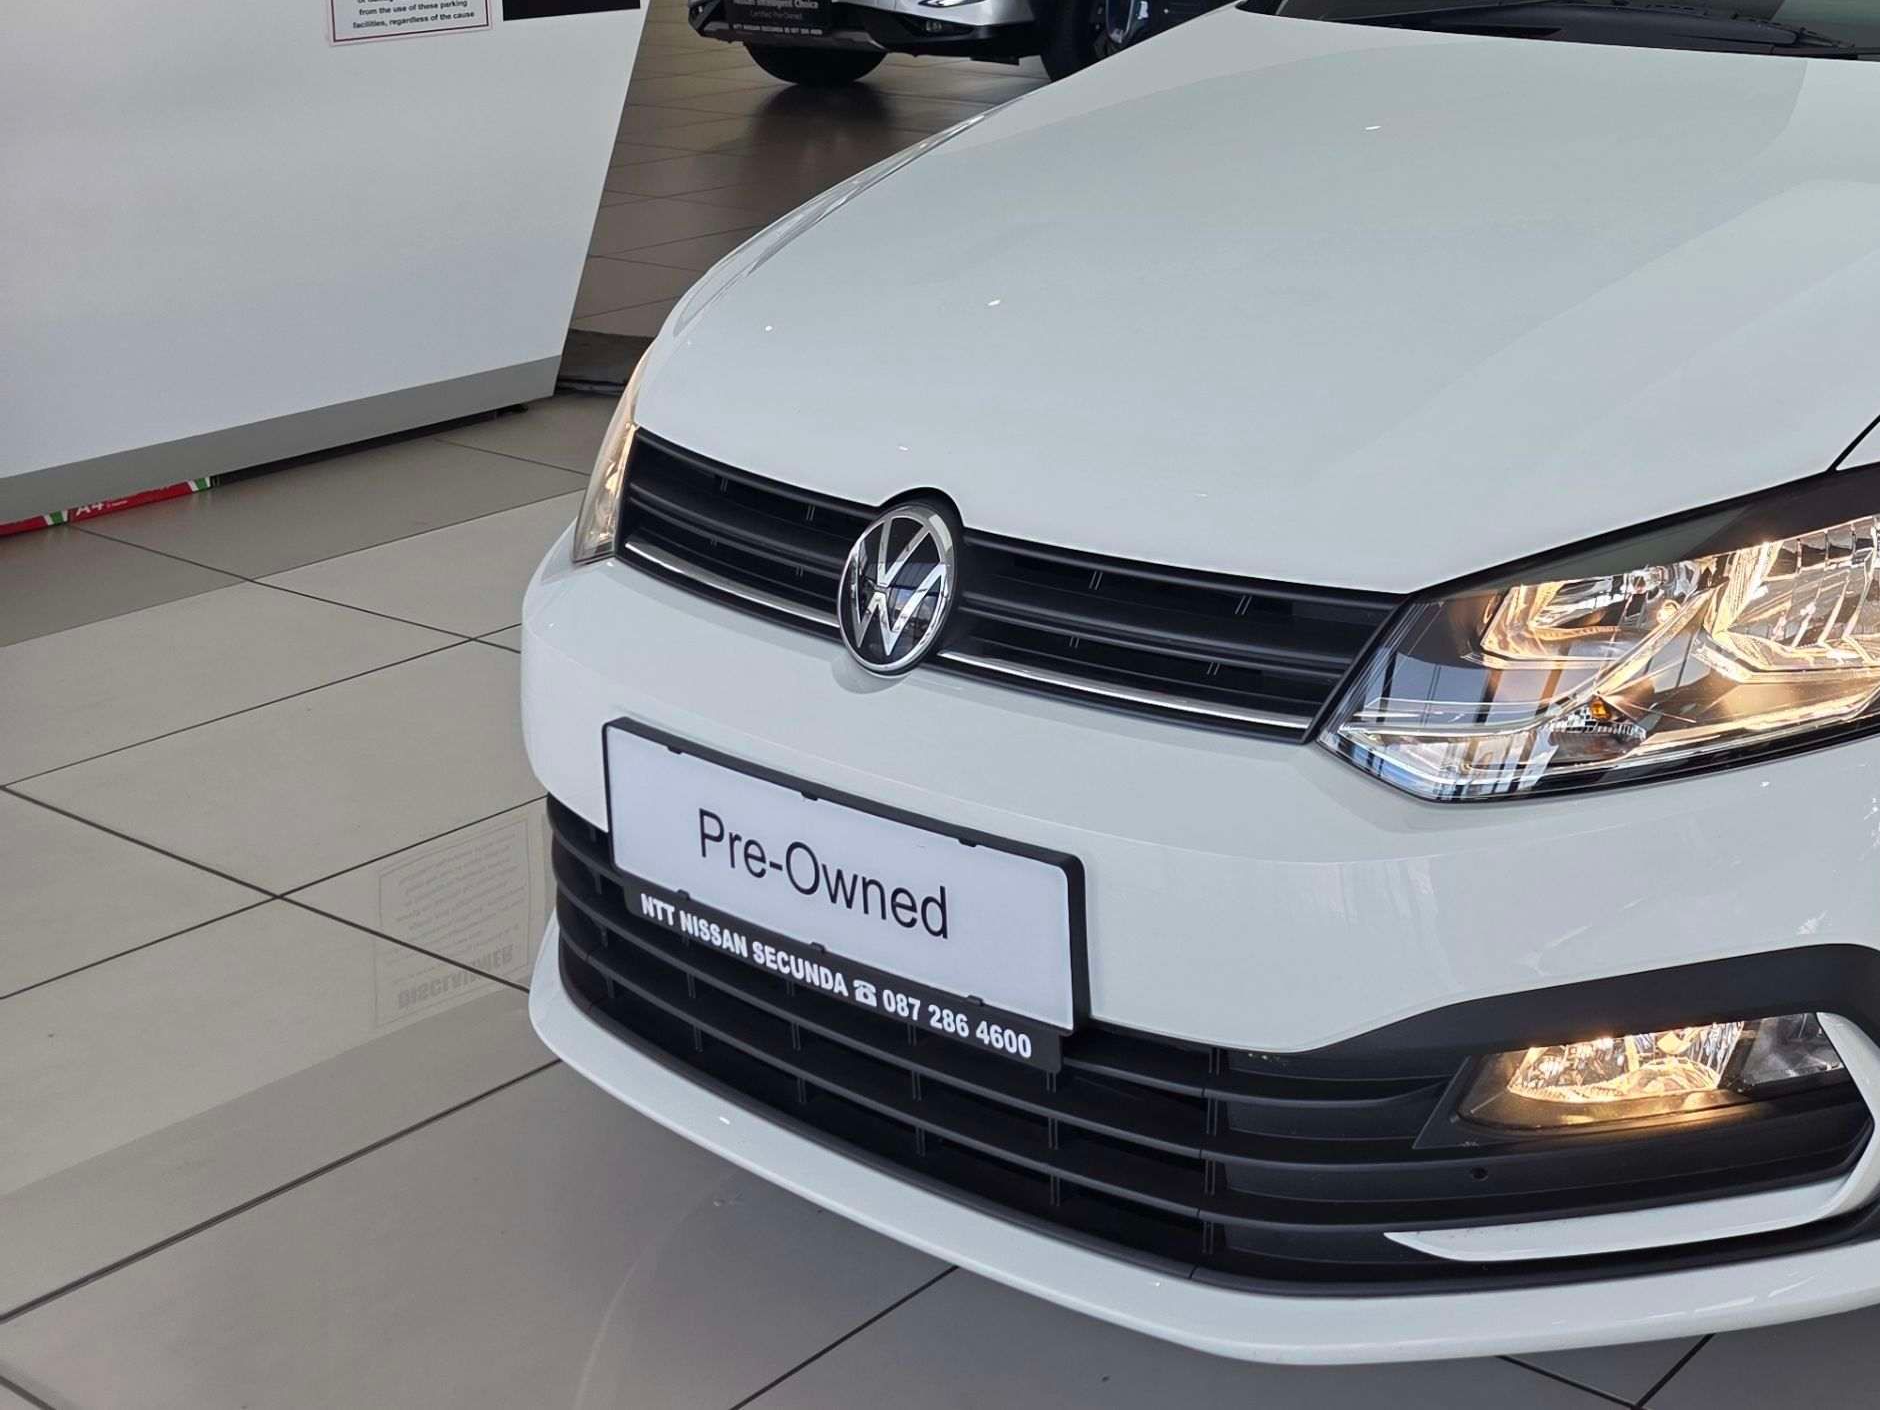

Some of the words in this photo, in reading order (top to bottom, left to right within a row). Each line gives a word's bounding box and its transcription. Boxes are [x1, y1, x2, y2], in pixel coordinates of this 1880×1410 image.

[379, 6, 391, 14] the
[408, 3, 416, 11] of
[418, 1, 438, 10] these
[440, 0, 468, 9] parking
[389, 15, 429, 26] regardless
[430, 13, 438, 21] of
[440, 12, 451, 20] the
[453, 11, 475, 19] cause
[698, 807, 949, 940] Pre-Owned
[641, 893, 675, 926] NTT
[679, 910, 748, 958] NISSAN
[752, 941, 849, 997] SECUNDA
[882, 989, 921, 1021] 087
[928, 1004, 970, 1038] 286
[975, 1020, 1032, 1058] 4600
